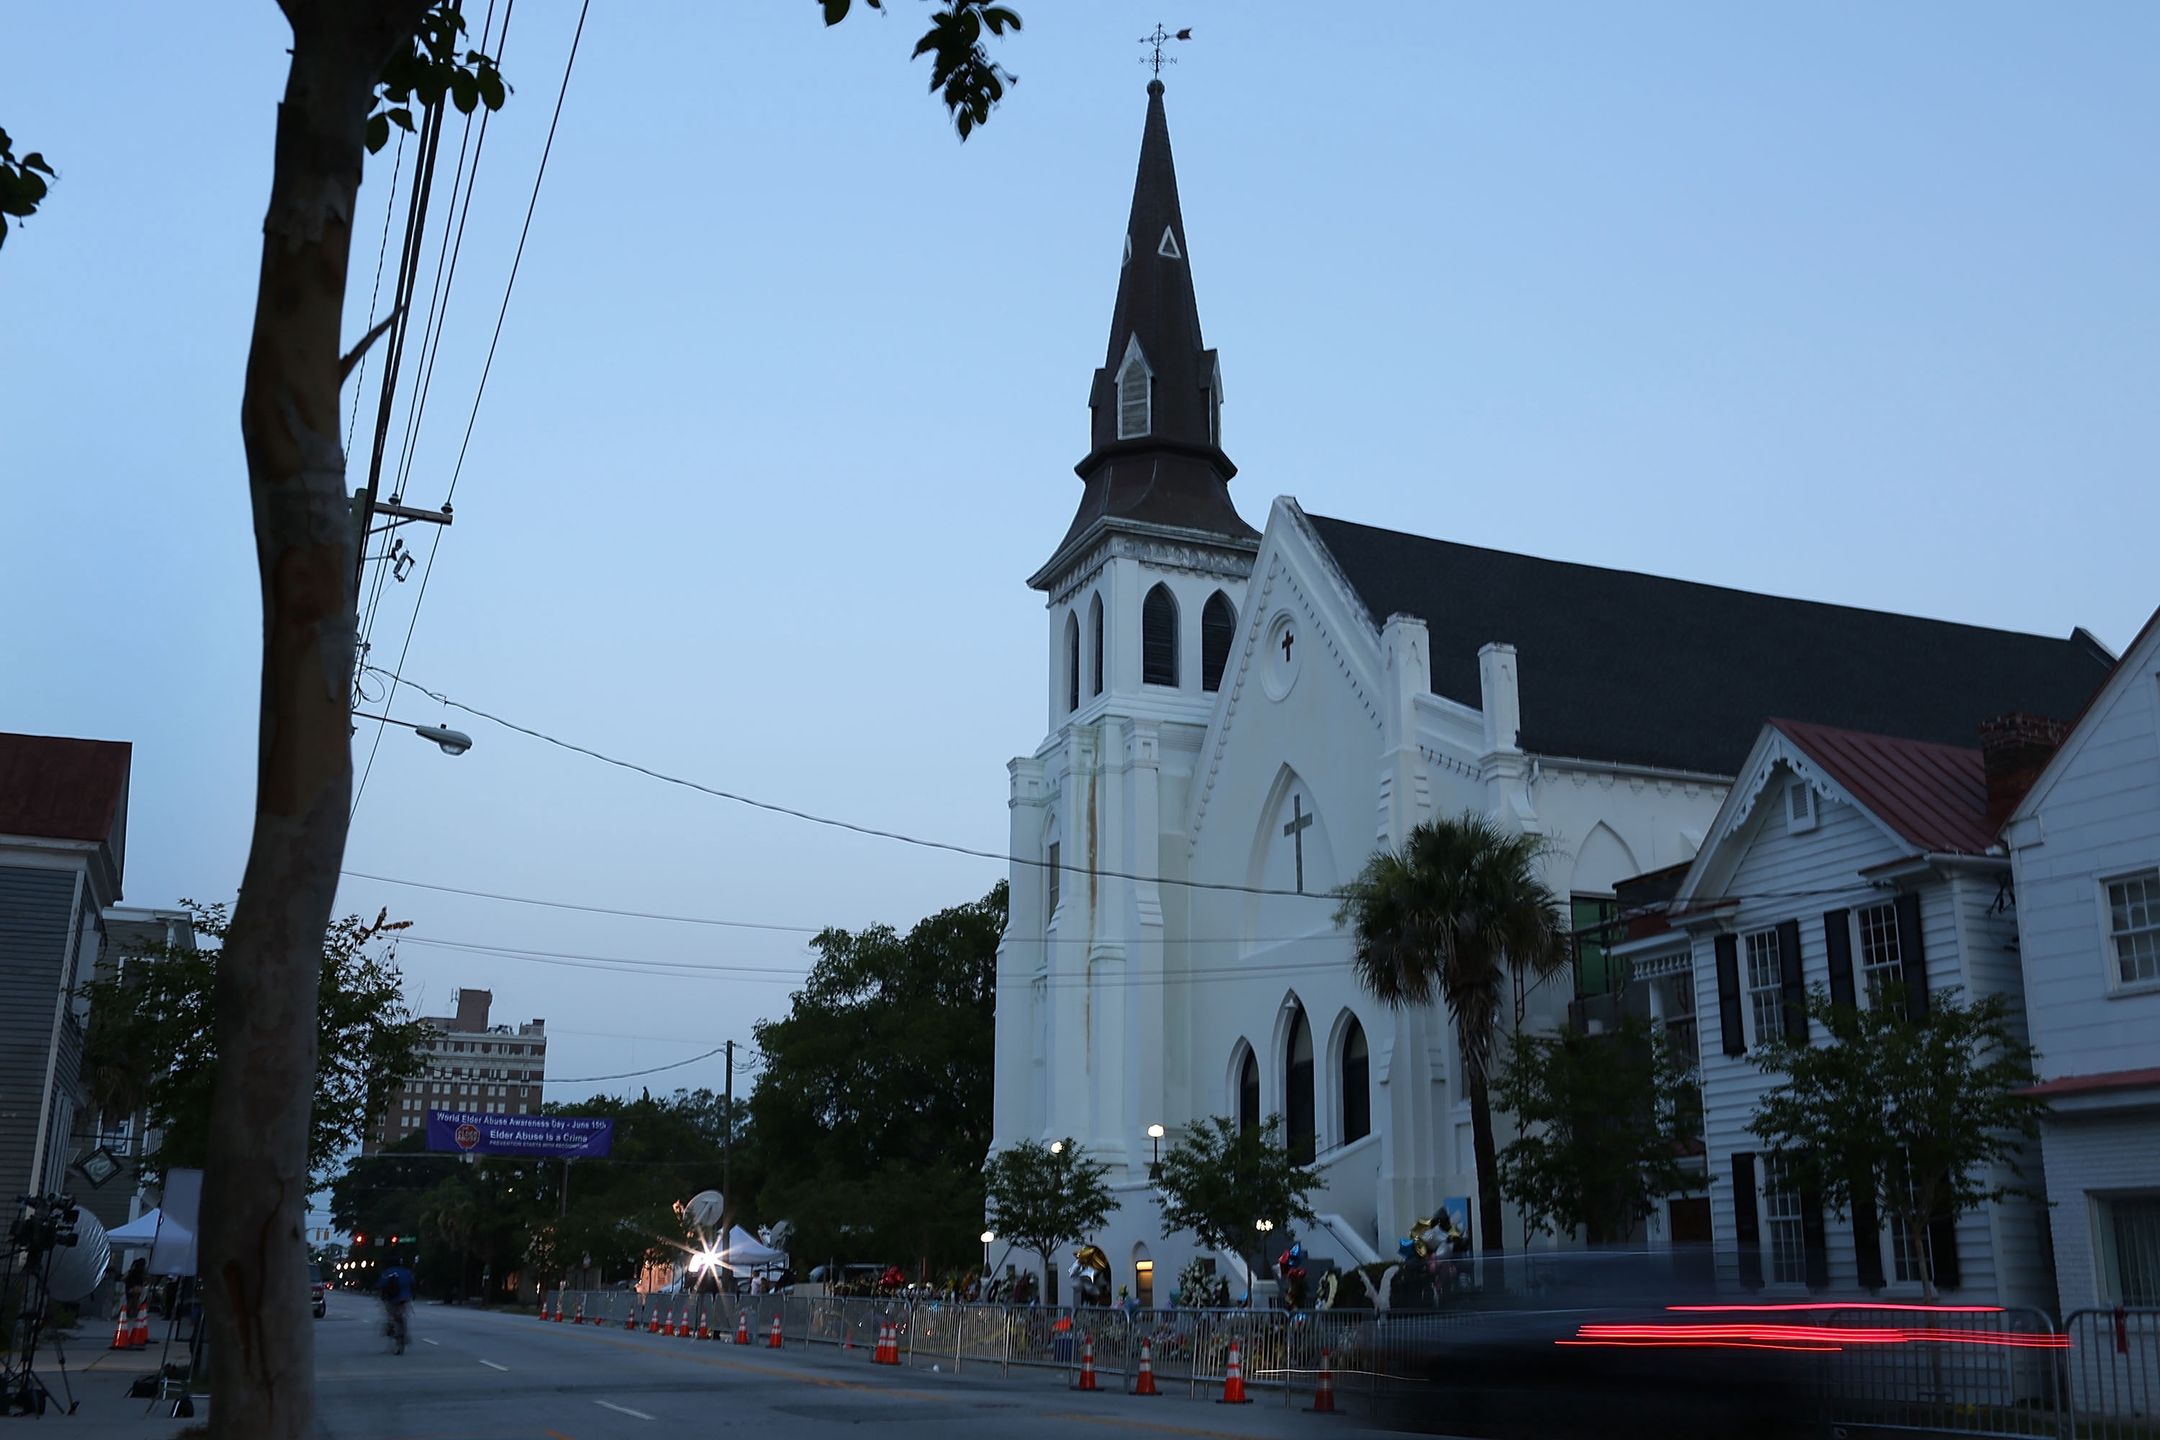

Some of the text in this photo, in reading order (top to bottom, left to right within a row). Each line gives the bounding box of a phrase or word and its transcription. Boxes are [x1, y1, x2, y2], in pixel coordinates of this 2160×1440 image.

[437, 1112, 460, 1122] World
[462, 1114, 481, 1123] Elder
[484, 1115, 507, 1126] Abuse
[509, 1117, 549, 1128] Awareness
[552, 1119, 565, 1129] Day
[571, 1120, 589, 1129] June
[592, 1120, 606, 1129] 15th
[490, 1130, 513, 1140] Elder
[515, 1131, 543, 1141] Abuse
[563, 1133, 587, 1143] Crime
